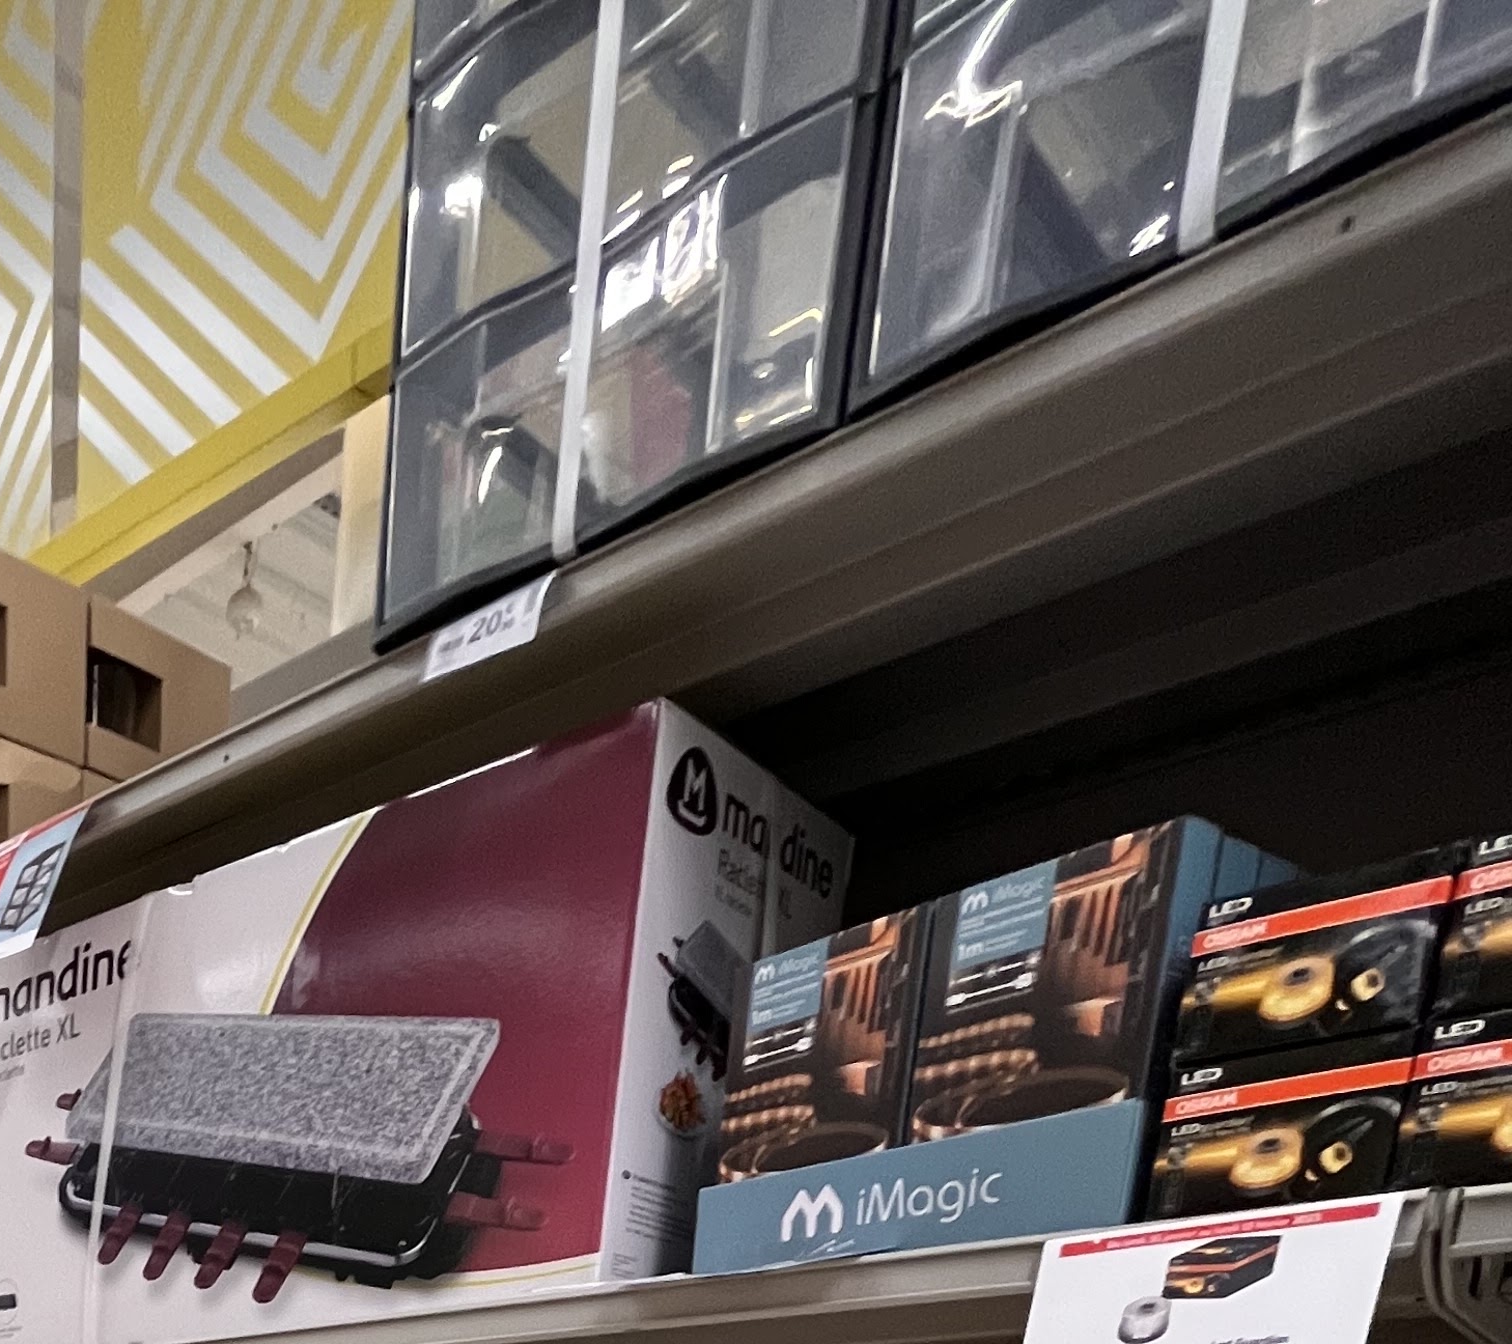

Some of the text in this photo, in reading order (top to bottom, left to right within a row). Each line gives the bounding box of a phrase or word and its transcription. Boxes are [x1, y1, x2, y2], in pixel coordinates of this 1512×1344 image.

[723, 792, 833, 898] madine
[1208, 897, 1253, 918] LED
[1202, 922, 1268, 948] OSRAM
[56, 1013, 81, 1042] XL
[1434, 1019, 1486, 1040] LED
[1427, 1047, 1503, 1073] OSRAM
[1181, 1068, 1223, 1086] LED
[1175, 1092, 1237, 1116] OSRAM
[856, 1166, 1002, 1226] iMagic
